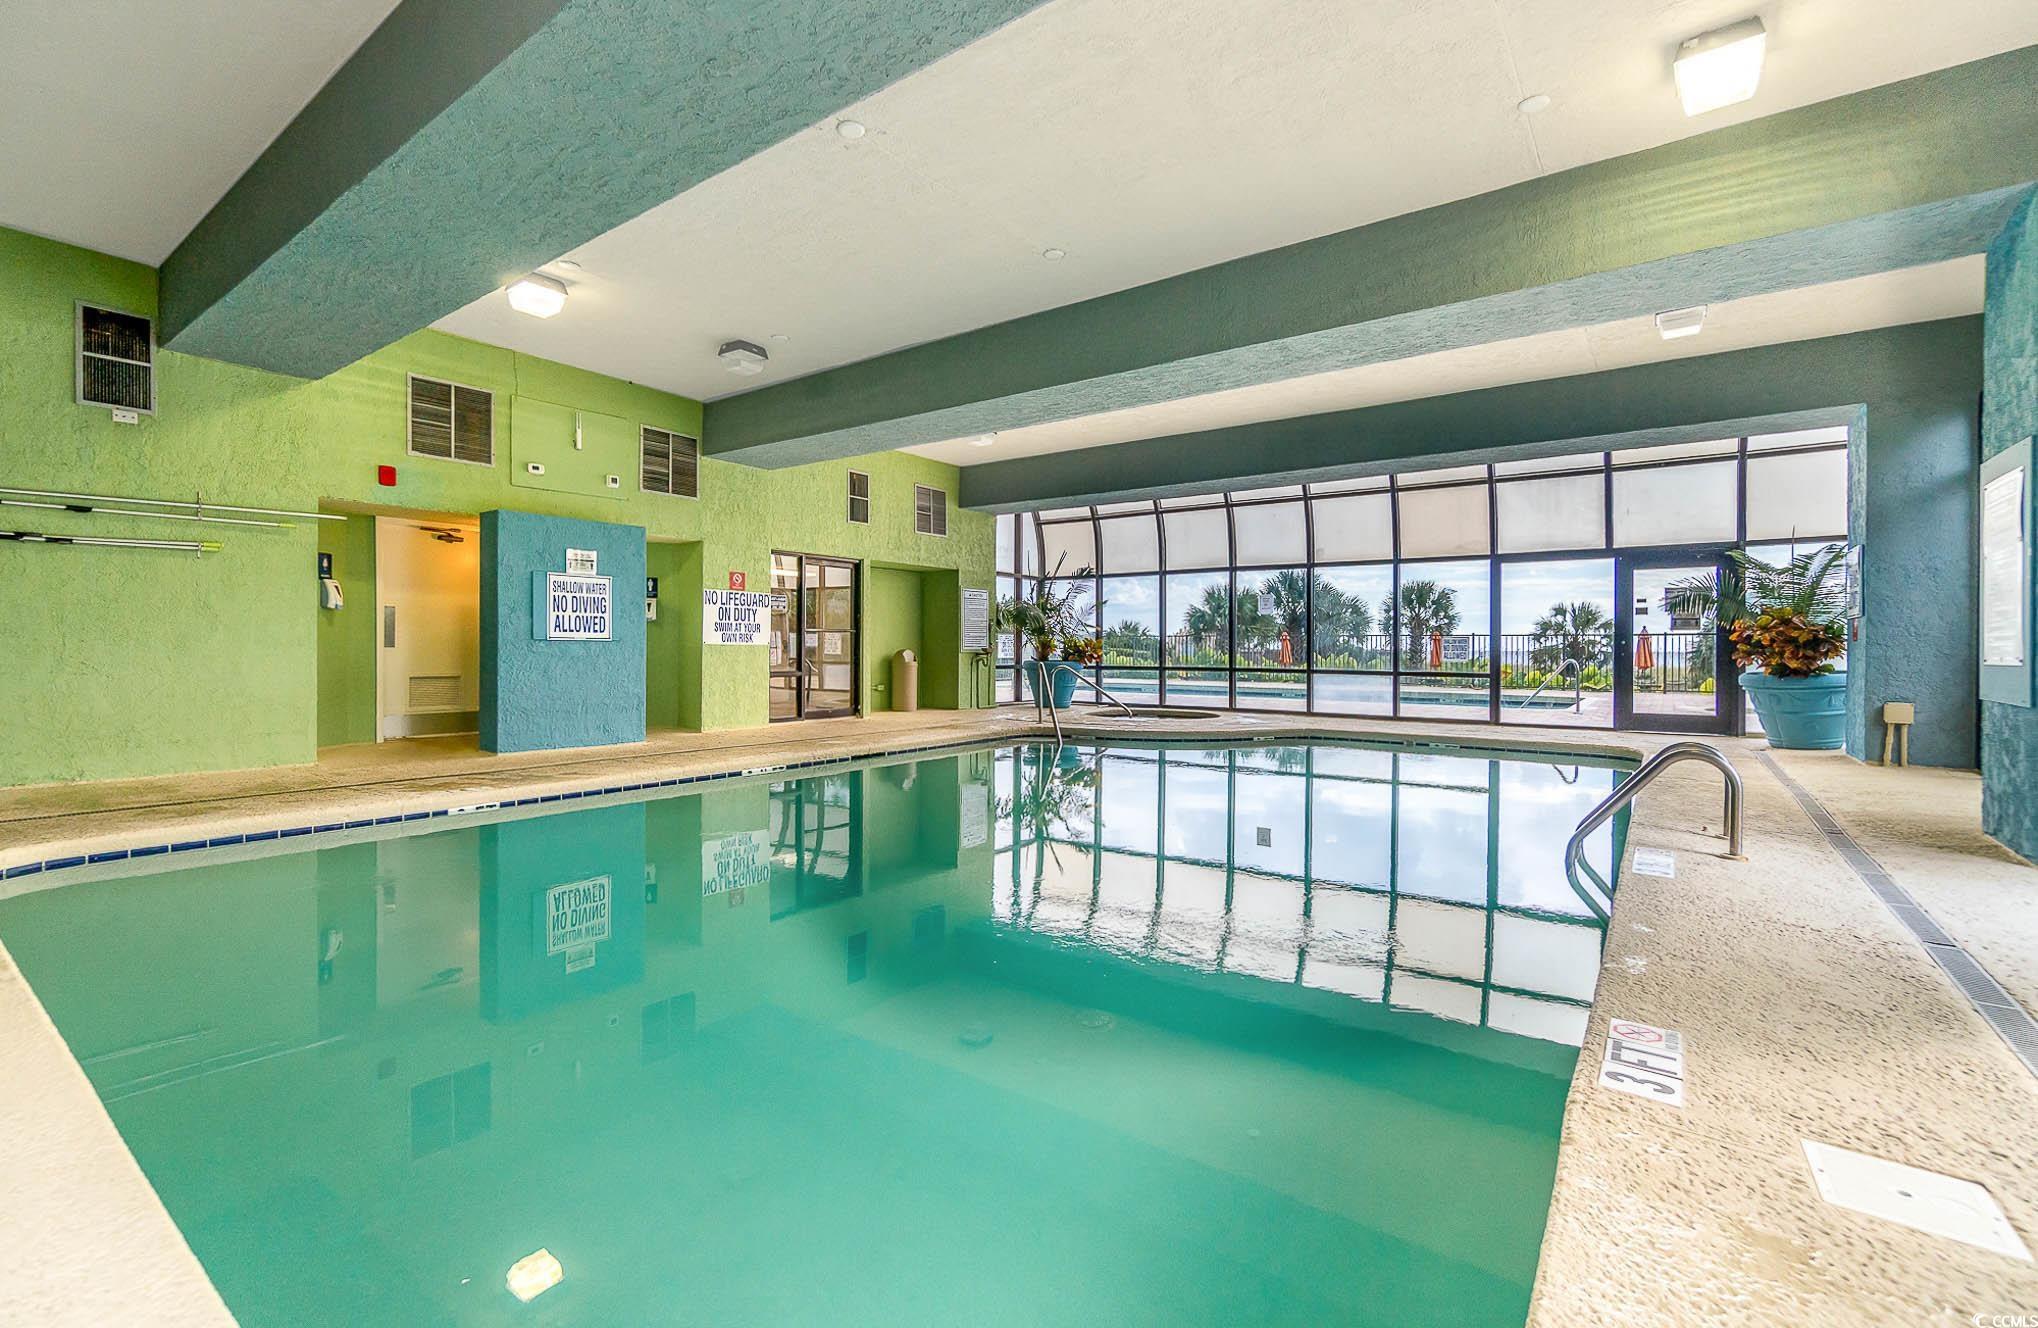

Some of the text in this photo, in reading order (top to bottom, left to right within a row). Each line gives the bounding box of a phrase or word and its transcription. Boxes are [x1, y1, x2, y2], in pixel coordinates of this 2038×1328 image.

[552, 580, 607, 595] SHALLOW WATER
[552, 594, 607, 614] NO DIVING
[704, 590, 718, 605] NO
[720, 591, 770, 608] LIFEGUARD
[718, 606, 758, 623] ON DUTY
[553, 614, 606, 633] ALLOWED
[714, 622, 761, 633] SWIM AT YOUR
[721, 632, 754, 643] OWN RISK
